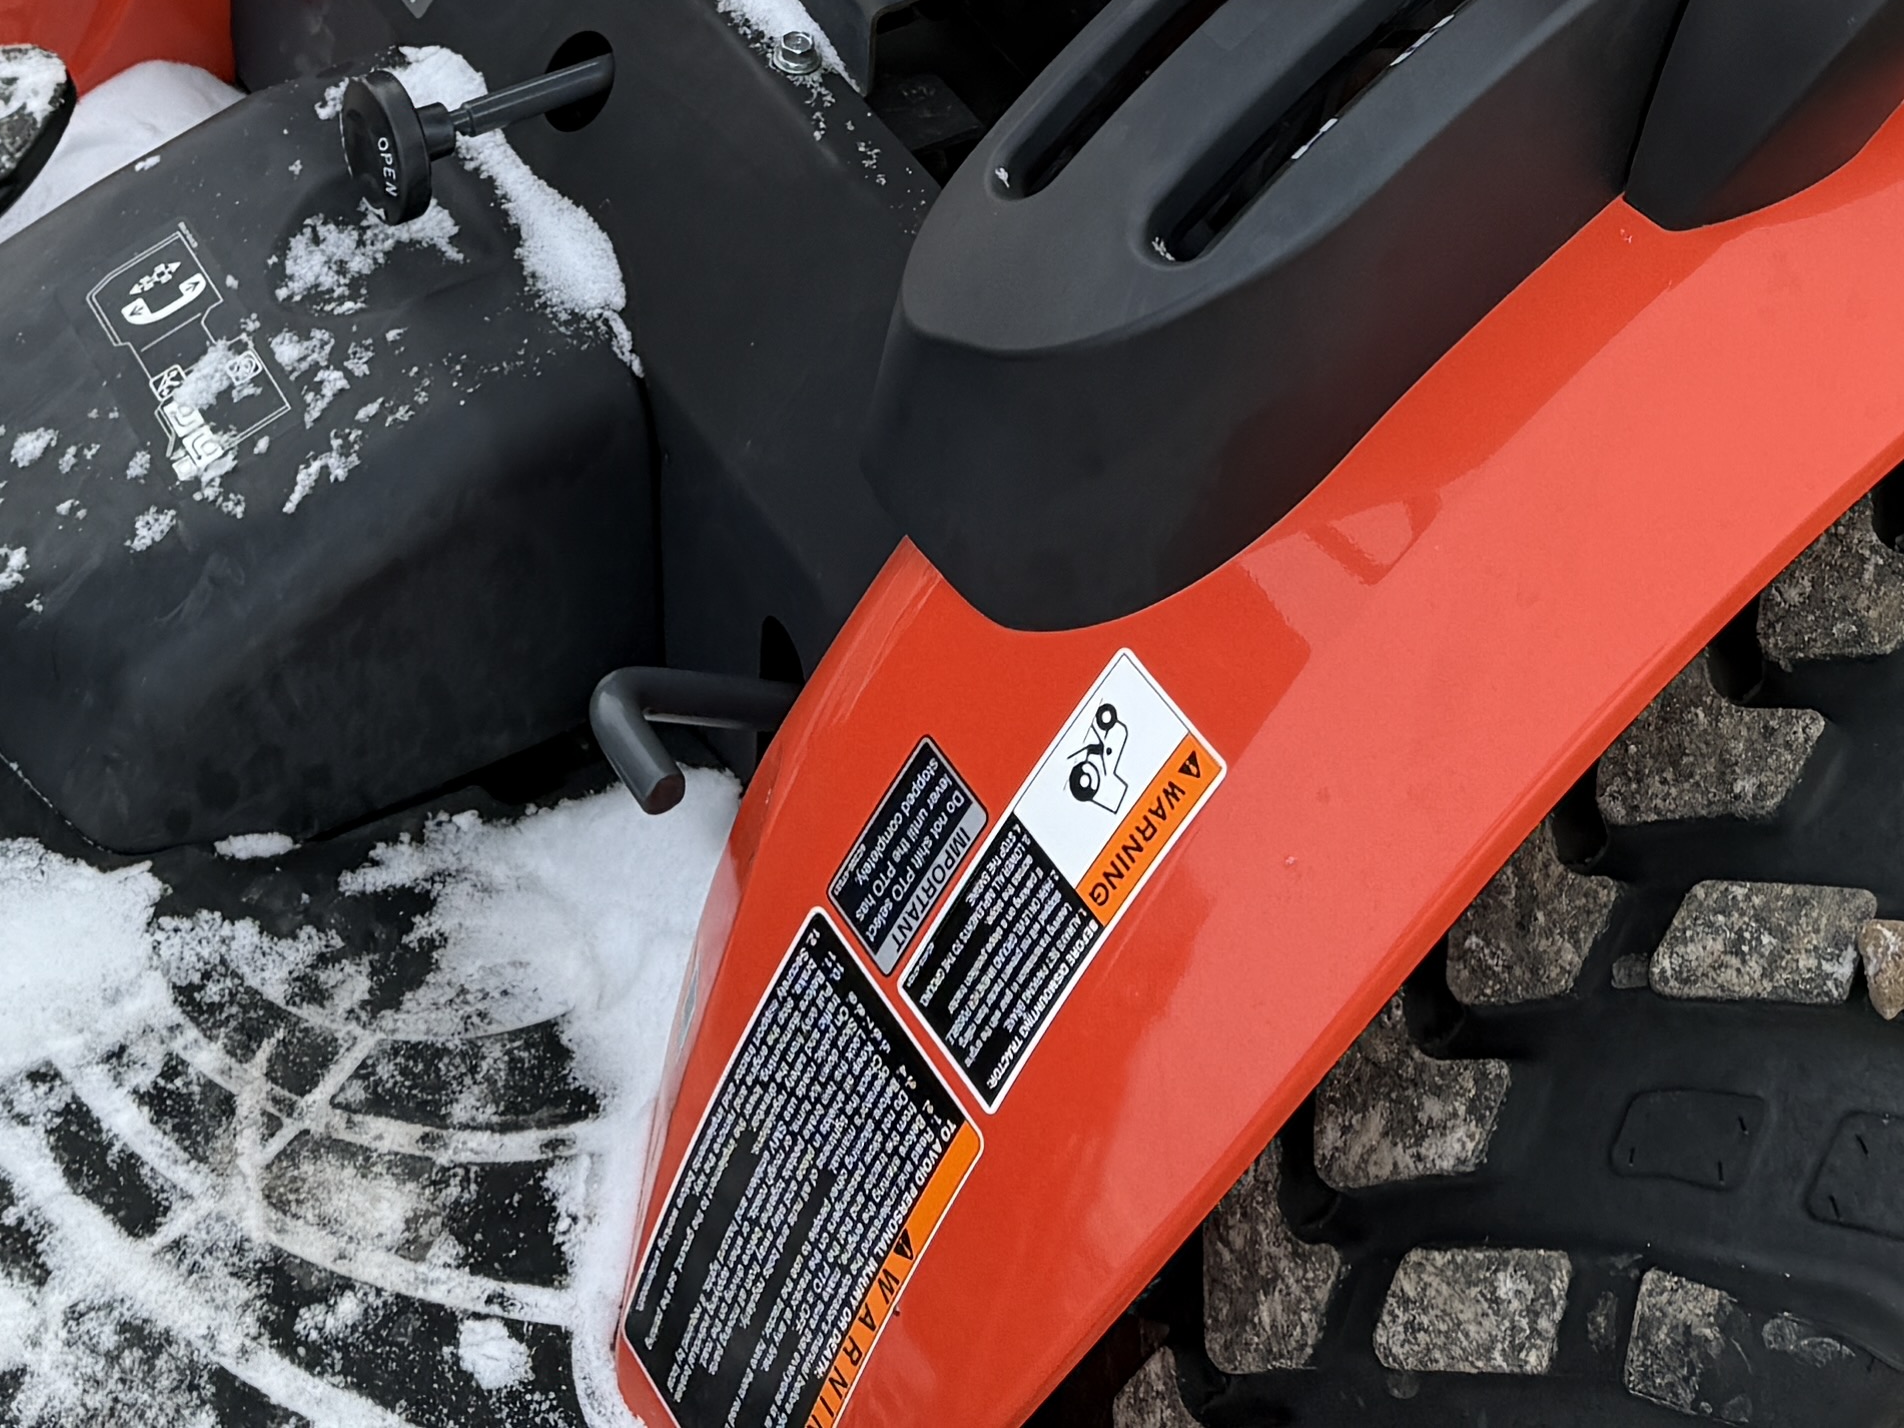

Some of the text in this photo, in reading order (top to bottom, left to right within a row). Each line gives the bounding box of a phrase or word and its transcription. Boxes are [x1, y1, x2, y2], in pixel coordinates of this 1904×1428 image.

[377, 137, 398, 197] OPEN
[854, 757, 938, 885] stopped completely.
[854, 772, 953, 922] lever until the PTO has
[864, 789, 965, 942] Do not shift PTO select
[1088, 780, 1185, 906] WARNING
[891, 826, 970, 952] IMPORTANT
[985, 918, 1098, 1089] BEFORE DISMOUNTING TRACTOR:
[812, 1260, 831, 1294] PTO
[813, 1118, 957, 1379] TO AVOID PERSONAL INJURY OR DEATH:
